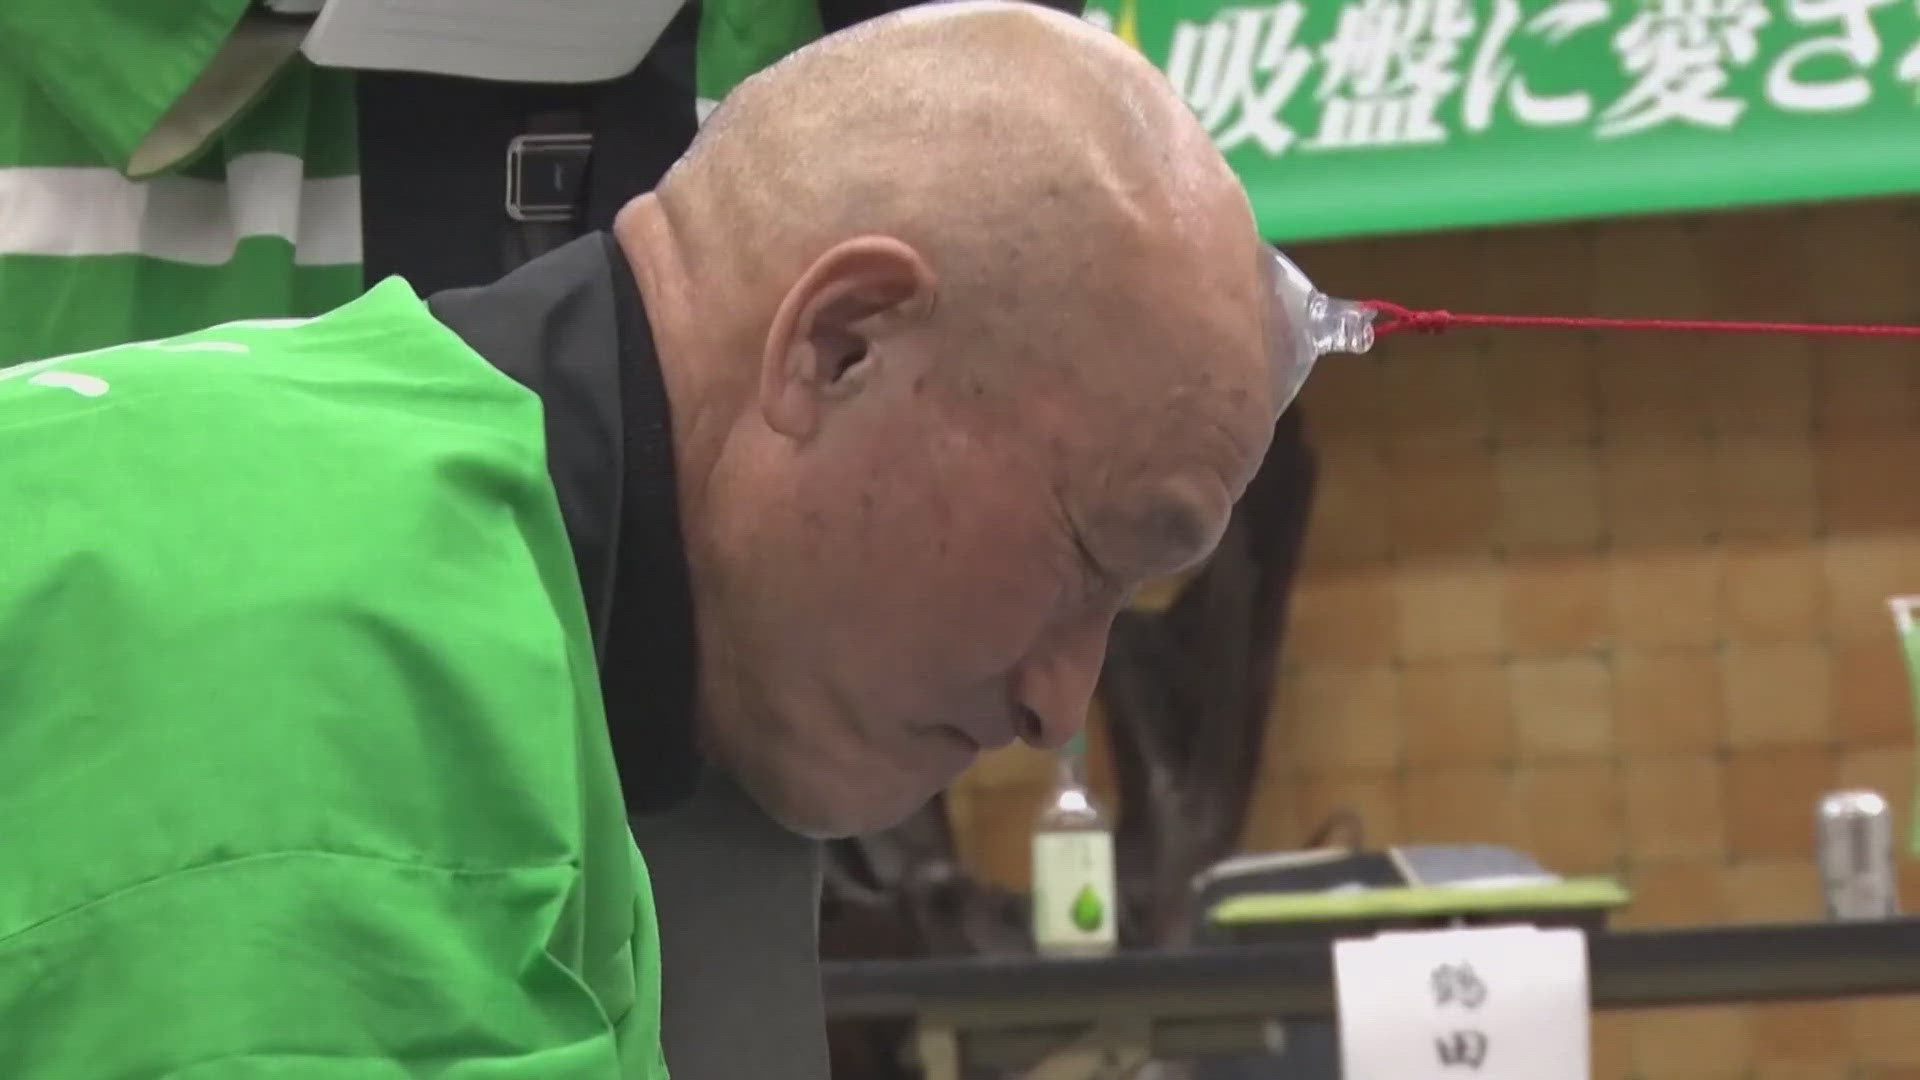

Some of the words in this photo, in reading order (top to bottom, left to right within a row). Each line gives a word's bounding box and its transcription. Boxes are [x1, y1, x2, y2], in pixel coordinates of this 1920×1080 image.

[1167, 0, 1920, 153] 吸盤に愛さ
